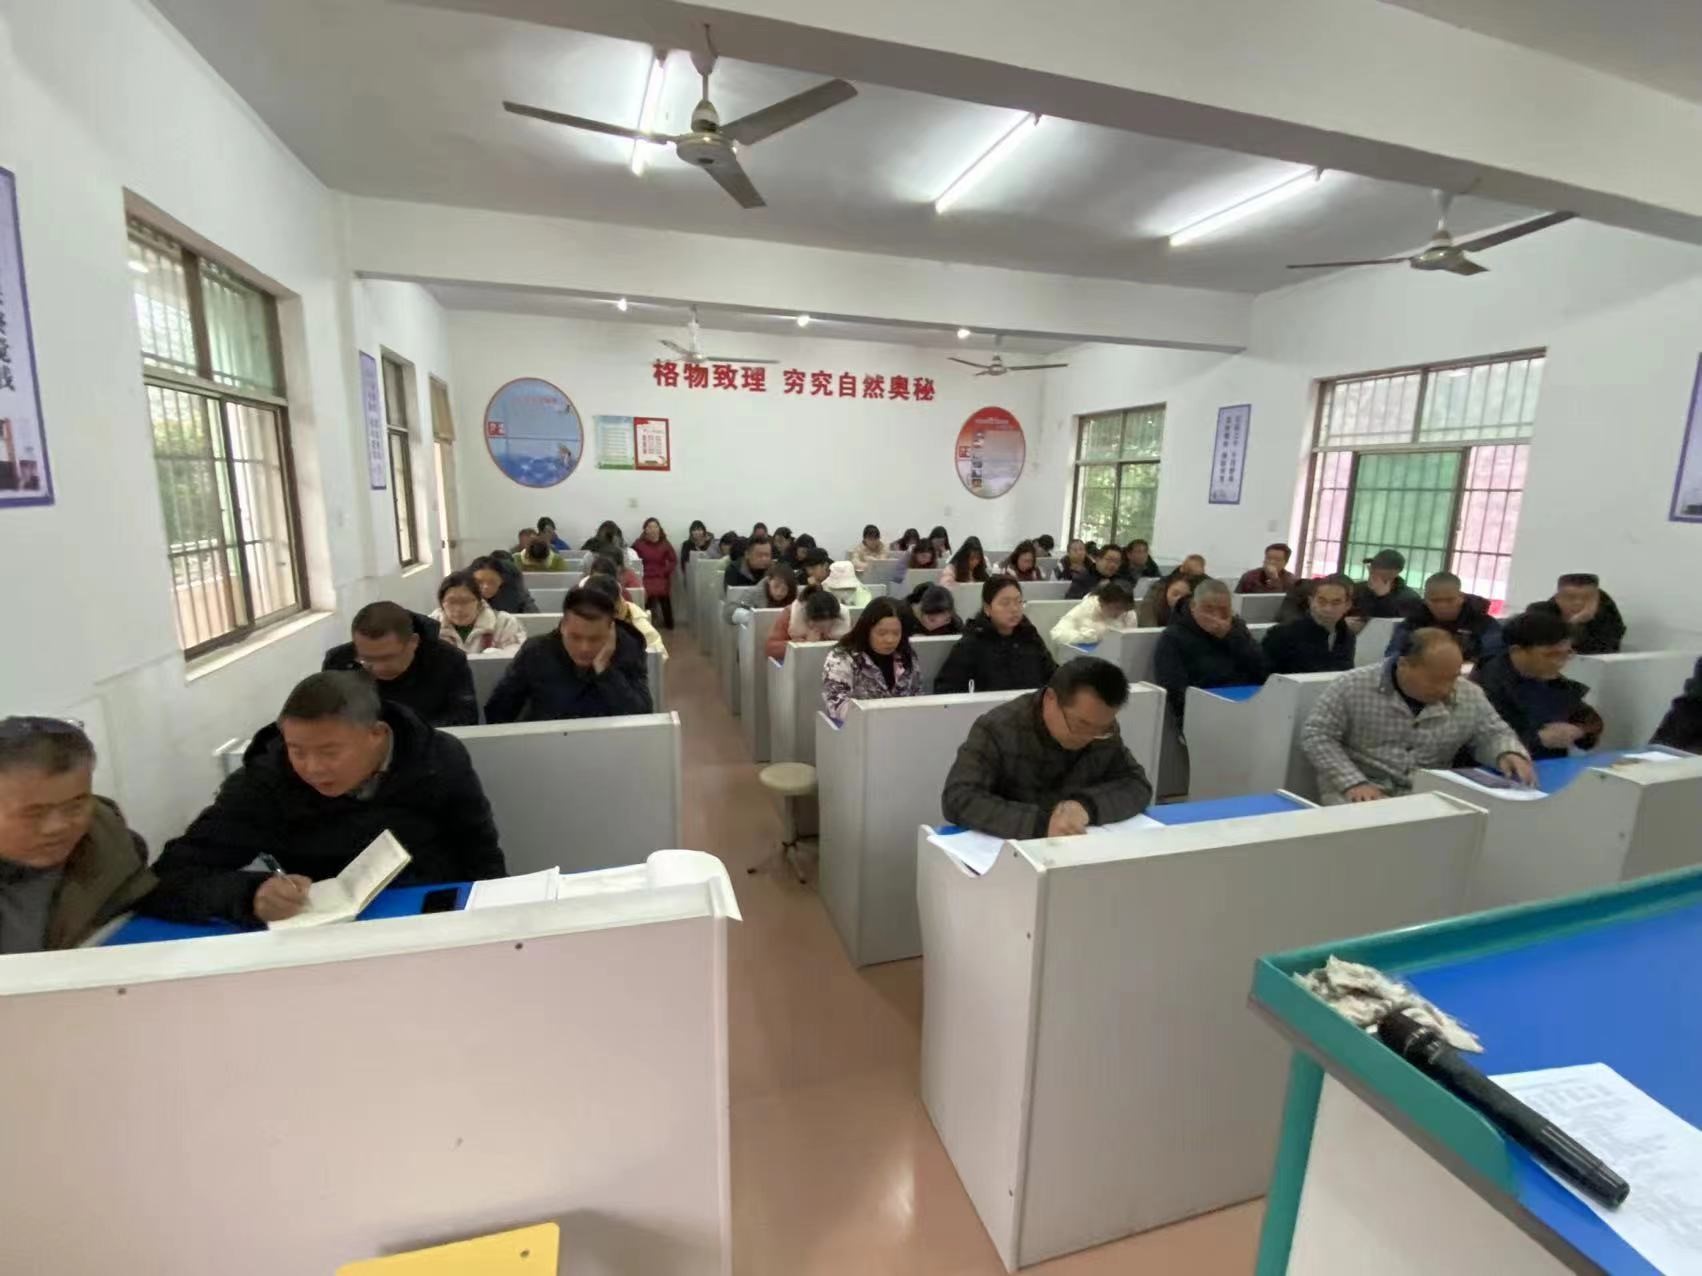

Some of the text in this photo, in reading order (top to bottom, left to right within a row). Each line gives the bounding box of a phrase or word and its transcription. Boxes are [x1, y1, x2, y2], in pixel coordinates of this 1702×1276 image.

[653, 359, 935, 401] 格物致理 穷究自然奥秘
